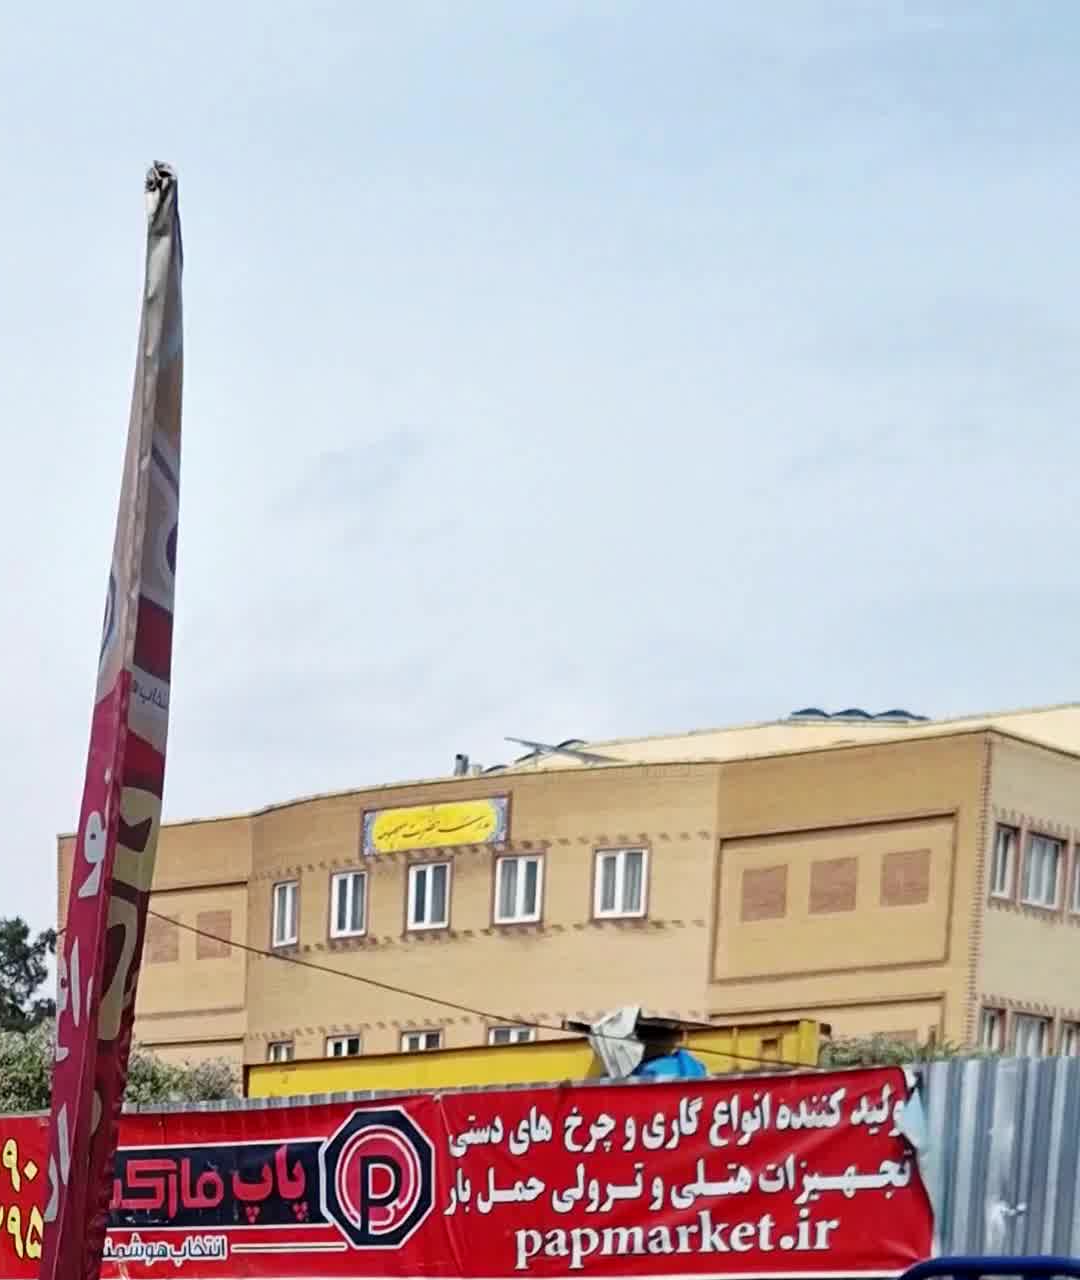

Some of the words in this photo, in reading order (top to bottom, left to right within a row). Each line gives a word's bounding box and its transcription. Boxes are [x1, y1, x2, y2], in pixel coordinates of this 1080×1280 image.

[508, 1105, 554, 1157] های
[562, 1106, 616, 1153] چرخ
[642, 1096, 703, 1150] گاری
[708, 1095, 772, 1148] انواع
[776, 1087, 847, 1130] کننده
[850, 1082, 905, 1137] ولید
[448, 1116, 505, 1159] دستی
[621, 1123, 637, 1152] و
[231, 1144, 308, 1225] پاپ
[443, 1167, 473, 1216] بار
[477, 1167, 546, 1214] حمل
[552, 1161, 644, 1215] ترولی
[649, 1175, 664, 1210] و
[670, 1158, 752, 1210] هتلی
[103, 1231, 170, 1267] هوشمن
[168, 1234, 227, 1267] انتخاب
[514, 1206, 840, 1271] papmarket.ir
